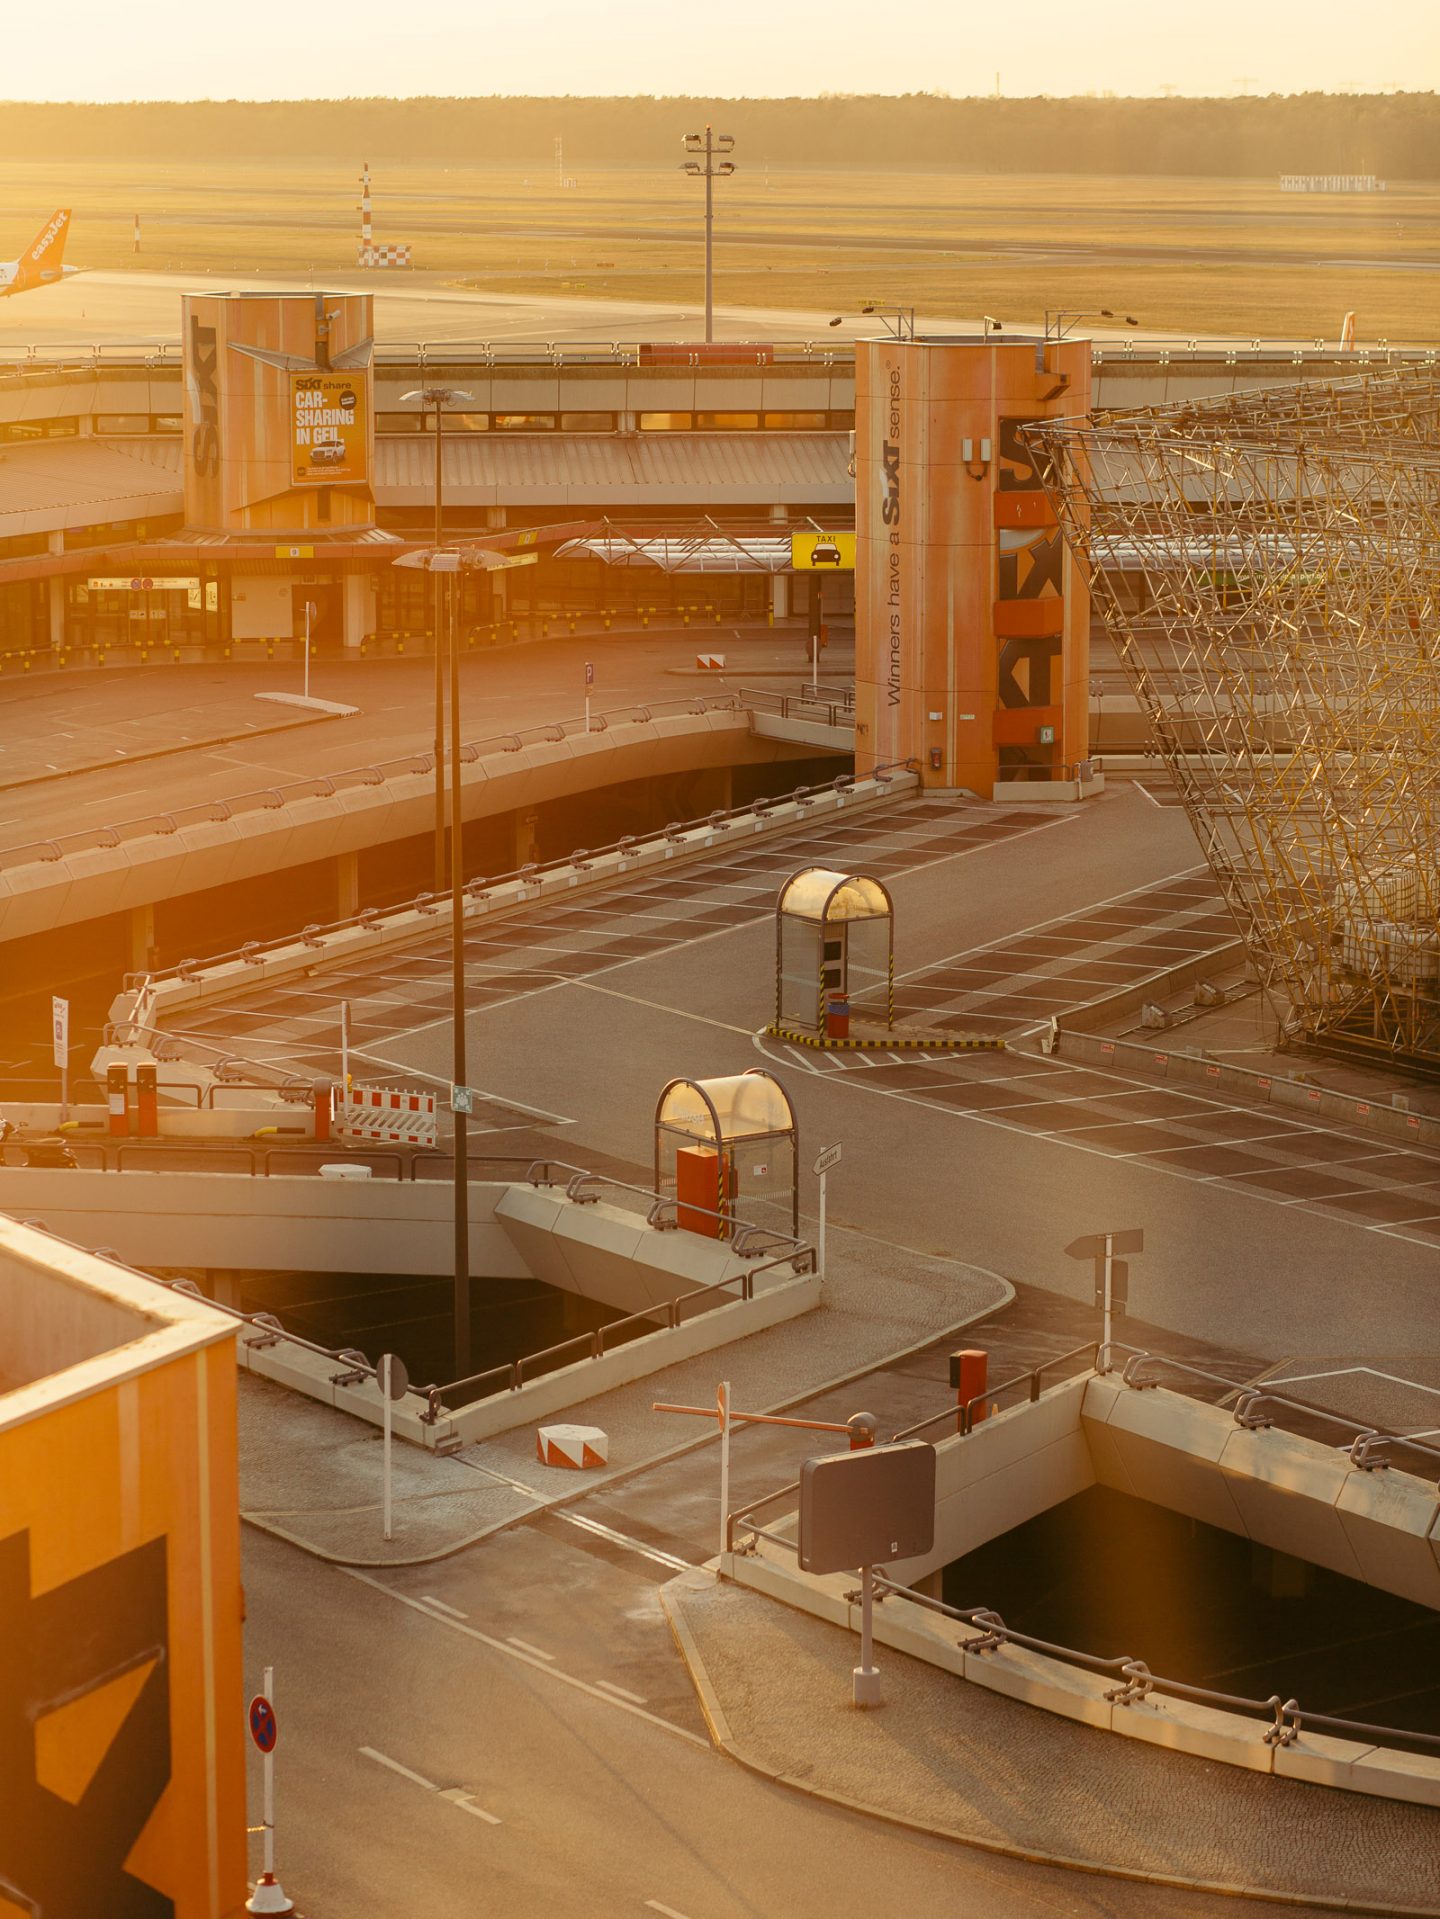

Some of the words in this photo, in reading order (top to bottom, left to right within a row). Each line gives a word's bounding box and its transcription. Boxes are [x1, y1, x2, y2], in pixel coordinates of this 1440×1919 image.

[32, 211, 68, 260] easyJet
[323, 382, 352, 390] share
[296, 391, 328, 408] CAR-
[296, 409, 355, 426] SHARING
[296, 428, 311, 445] IN
[816, 535, 836, 543] TAXI
[890, 532, 901, 546] a
[887, 553, 901, 607] have
[887, 614, 901, 707] Winners
